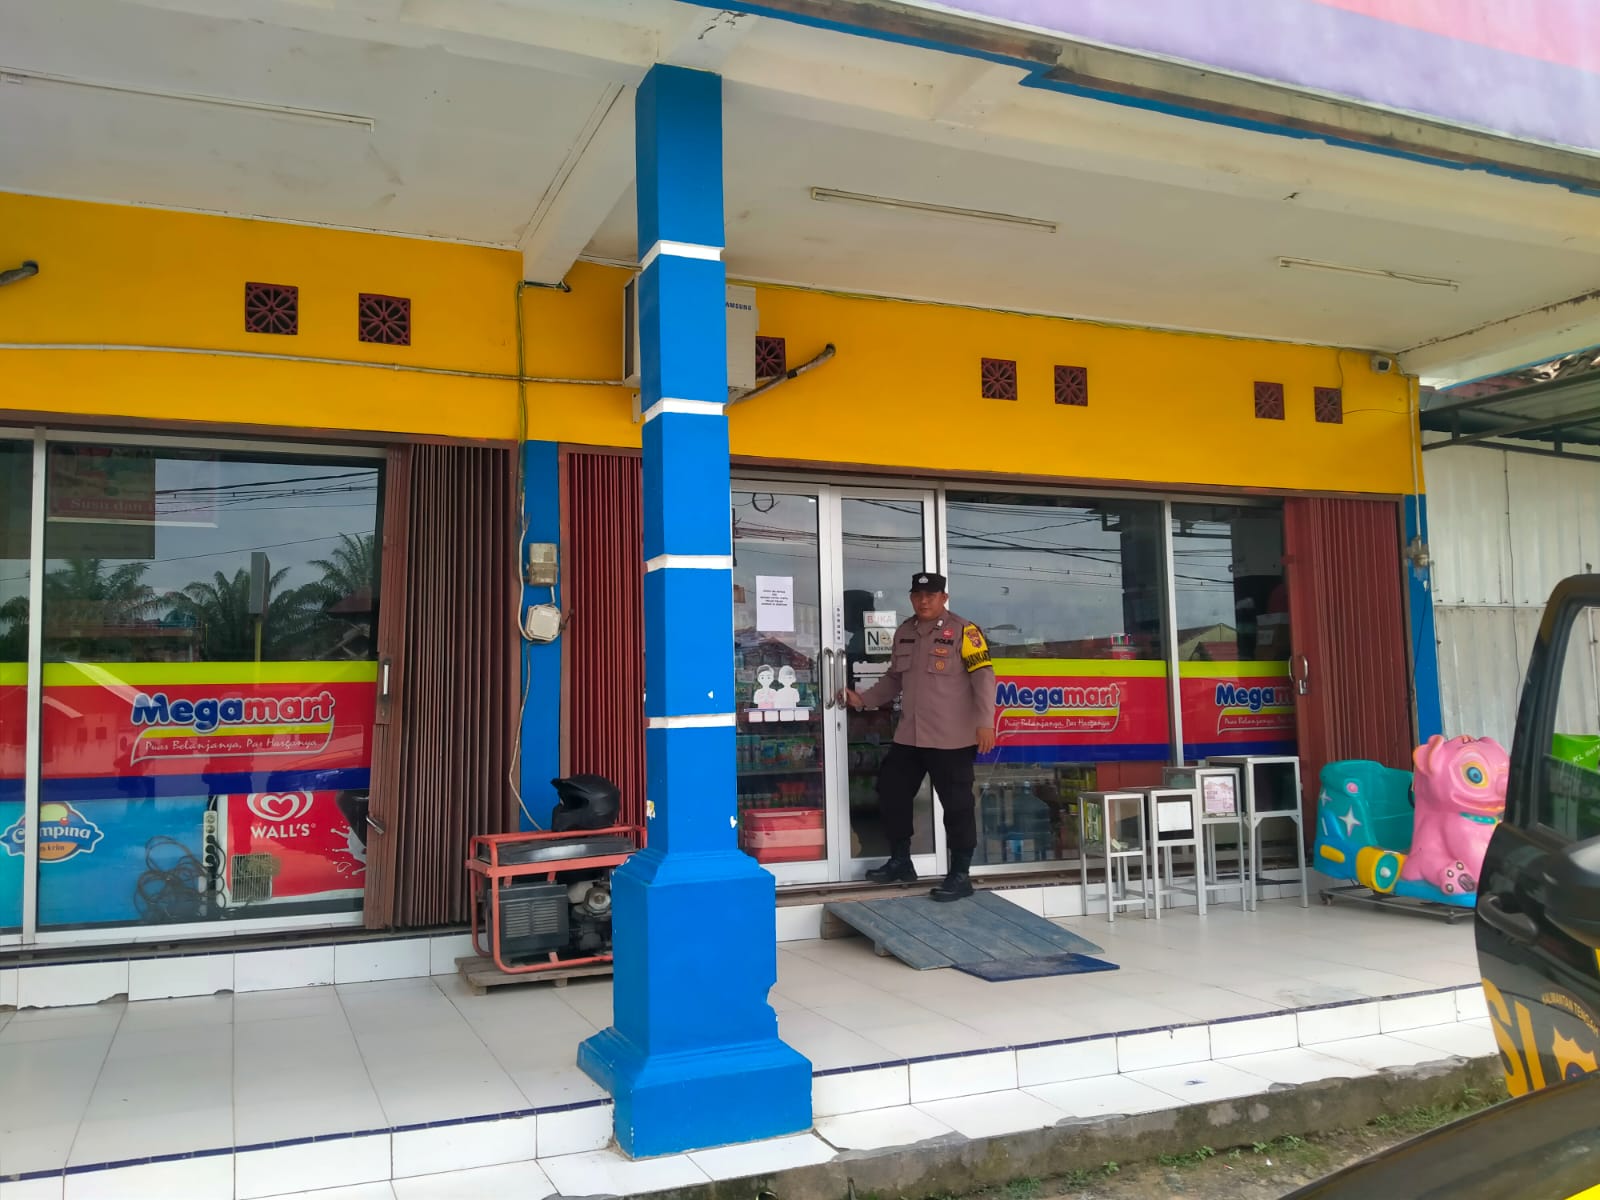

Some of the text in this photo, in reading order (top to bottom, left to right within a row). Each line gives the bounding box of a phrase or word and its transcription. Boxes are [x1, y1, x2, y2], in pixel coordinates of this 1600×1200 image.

[995, 681, 1120, 713] Megamart
[130, 690, 336, 733] Megamart
[12, 826, 91, 844] Cmpina
[250, 823, 310, 839] WALL'S
